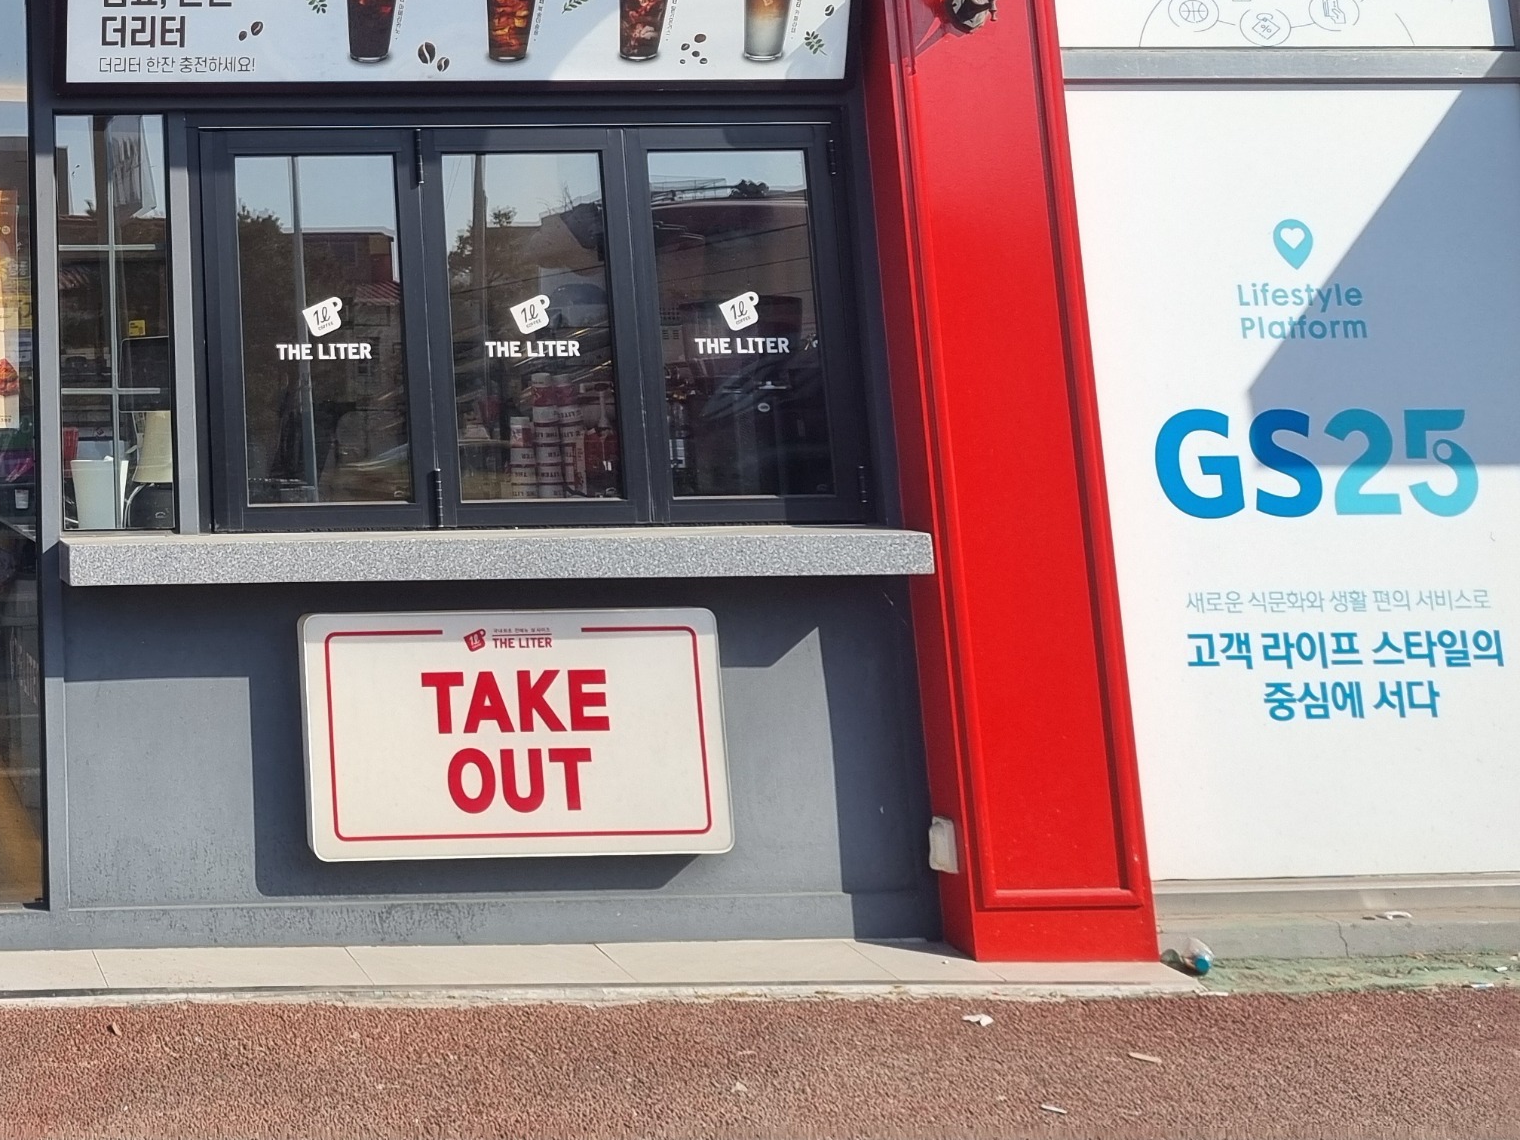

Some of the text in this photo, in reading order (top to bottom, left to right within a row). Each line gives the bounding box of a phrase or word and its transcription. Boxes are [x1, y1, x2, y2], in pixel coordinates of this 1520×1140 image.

[101, 16, 186, 48] 더리터
[99, 57, 255, 73] 더리터 한잔 충전하세요!
[1237, 282, 1363, 313] Lifestyle
[1240, 314, 1368, 340] Platform
[275, 342, 373, 360] THE LITER
[484, 340, 581, 358] THE LITER
[694, 337, 790, 354] THE LITER
[1154, 407, 1480, 519] GS25
[1186, 588, 1492, 614] 새로운 식문화와 생활 편의 서비스로
[492, 637, 553, 649] THE LITER
[1187, 629, 1505, 670] 고객 라이프 스타일의
[421, 668, 611, 735] TAKE
[1263, 680, 1441, 721] 중심에 서다
[446, 746, 593, 814] OUT
